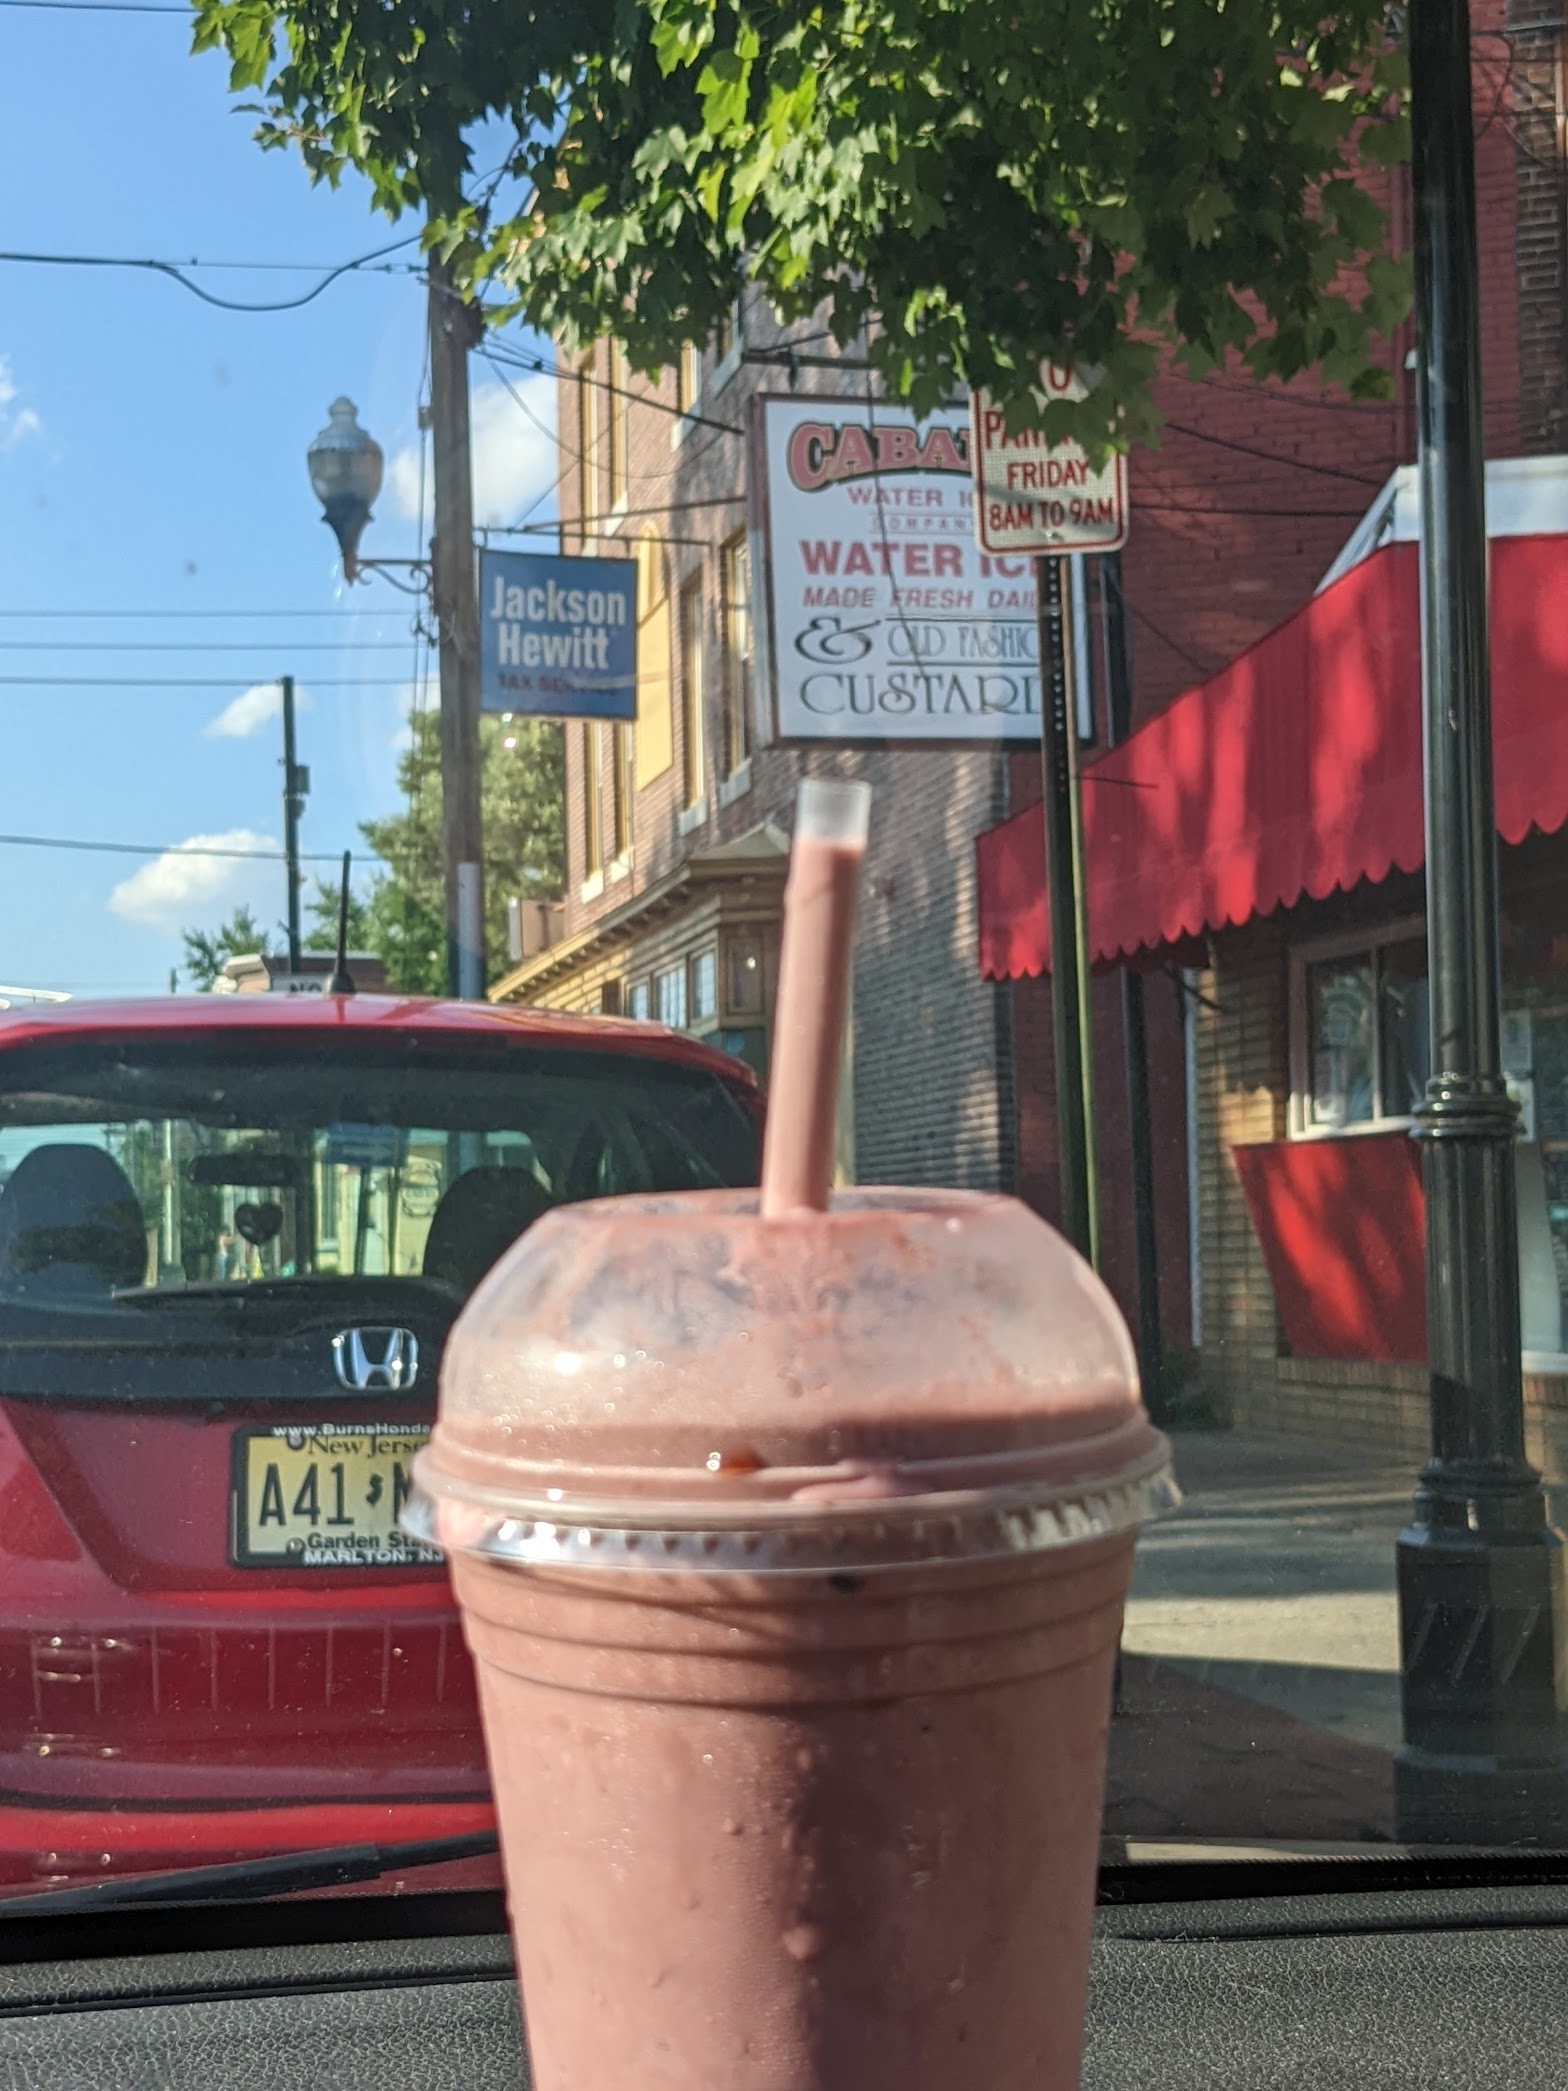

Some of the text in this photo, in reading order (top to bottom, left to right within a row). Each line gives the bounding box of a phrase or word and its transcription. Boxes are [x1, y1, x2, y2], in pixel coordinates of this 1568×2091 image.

[1006, 459, 1089, 491] FRIDAY
[847, 486, 944, 508] WATER
[870, 516, 975, 530] COMPAN
[989, 497, 1116, 532] 8AM TO 9AM
[799, 540, 1038, 579] WATER IC
[489, 575, 627, 626] Jackson
[802, 586, 875, 608] MADE
[889, 586, 974, 609] FRESH
[498, 621, 610, 670] Hewitt
[794, 616, 1039, 665] & OLD FASHIO
[273, 1422, 431, 1437] www.BurnsHonda
[307, 1435, 420, 1458] New Jers
[258, 1461, 355, 1527] A41
[307, 1531, 380, 1549] Garden
